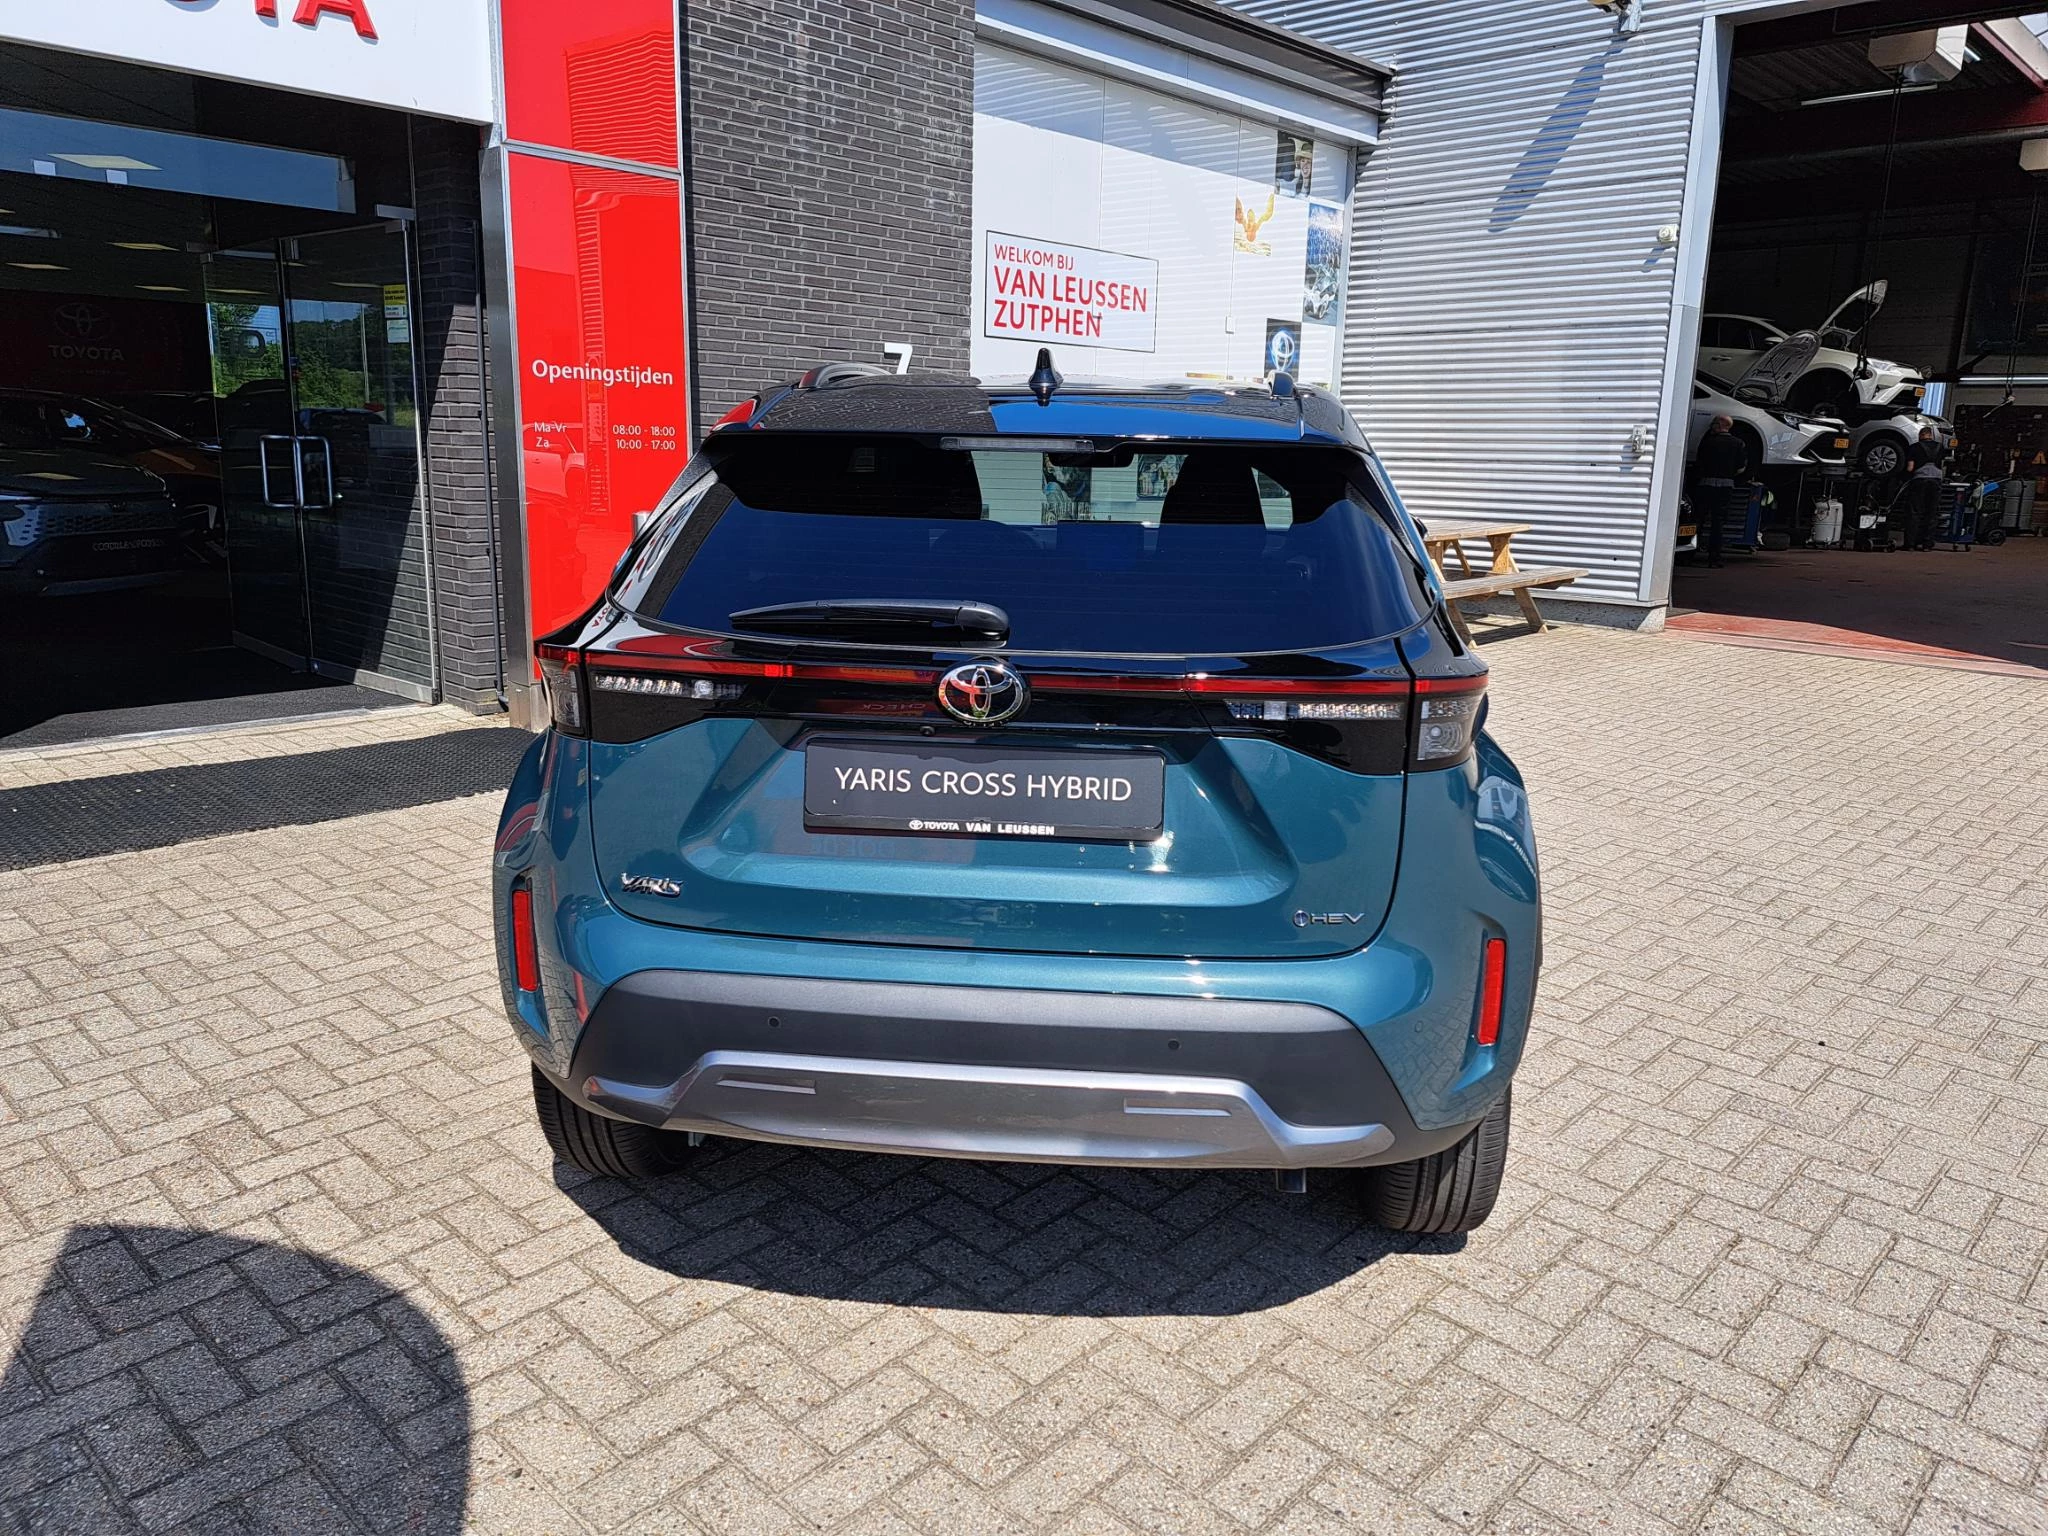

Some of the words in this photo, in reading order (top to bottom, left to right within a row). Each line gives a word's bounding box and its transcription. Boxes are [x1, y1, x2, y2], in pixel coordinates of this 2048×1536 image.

[994, 244, 1053, 267] WELKOM
[1057, 254, 1074, 271] BIJ
[994, 265, 1045, 299] VAN
[1052, 274, 1147, 312] LEUSSEN
[993, 299, 1102, 337] ZUTPHEN
[884, 342, 913, 375] 7
[532, 359, 673, 388] Openingstijden
[534, 422, 567, 433] Ma-Vr
[612, 424, 642, 436] 08:00
[651, 425, 675, 437] 18:00
[536, 437, 550, 448] Za
[616, 439, 642, 450] 10:00
[652, 439, 676, 450] 17:00
[835, 767, 912, 793] YARIS
[921, 770, 1016, 797] CROSS
[1026, 774, 1132, 801] HYBRID
[924, 821, 960, 832] TOYOTA
[966, 822, 991, 833] VAN
[997, 823, 1055, 836] LEUSSEN
[1311, 912, 1365, 924] HEV
